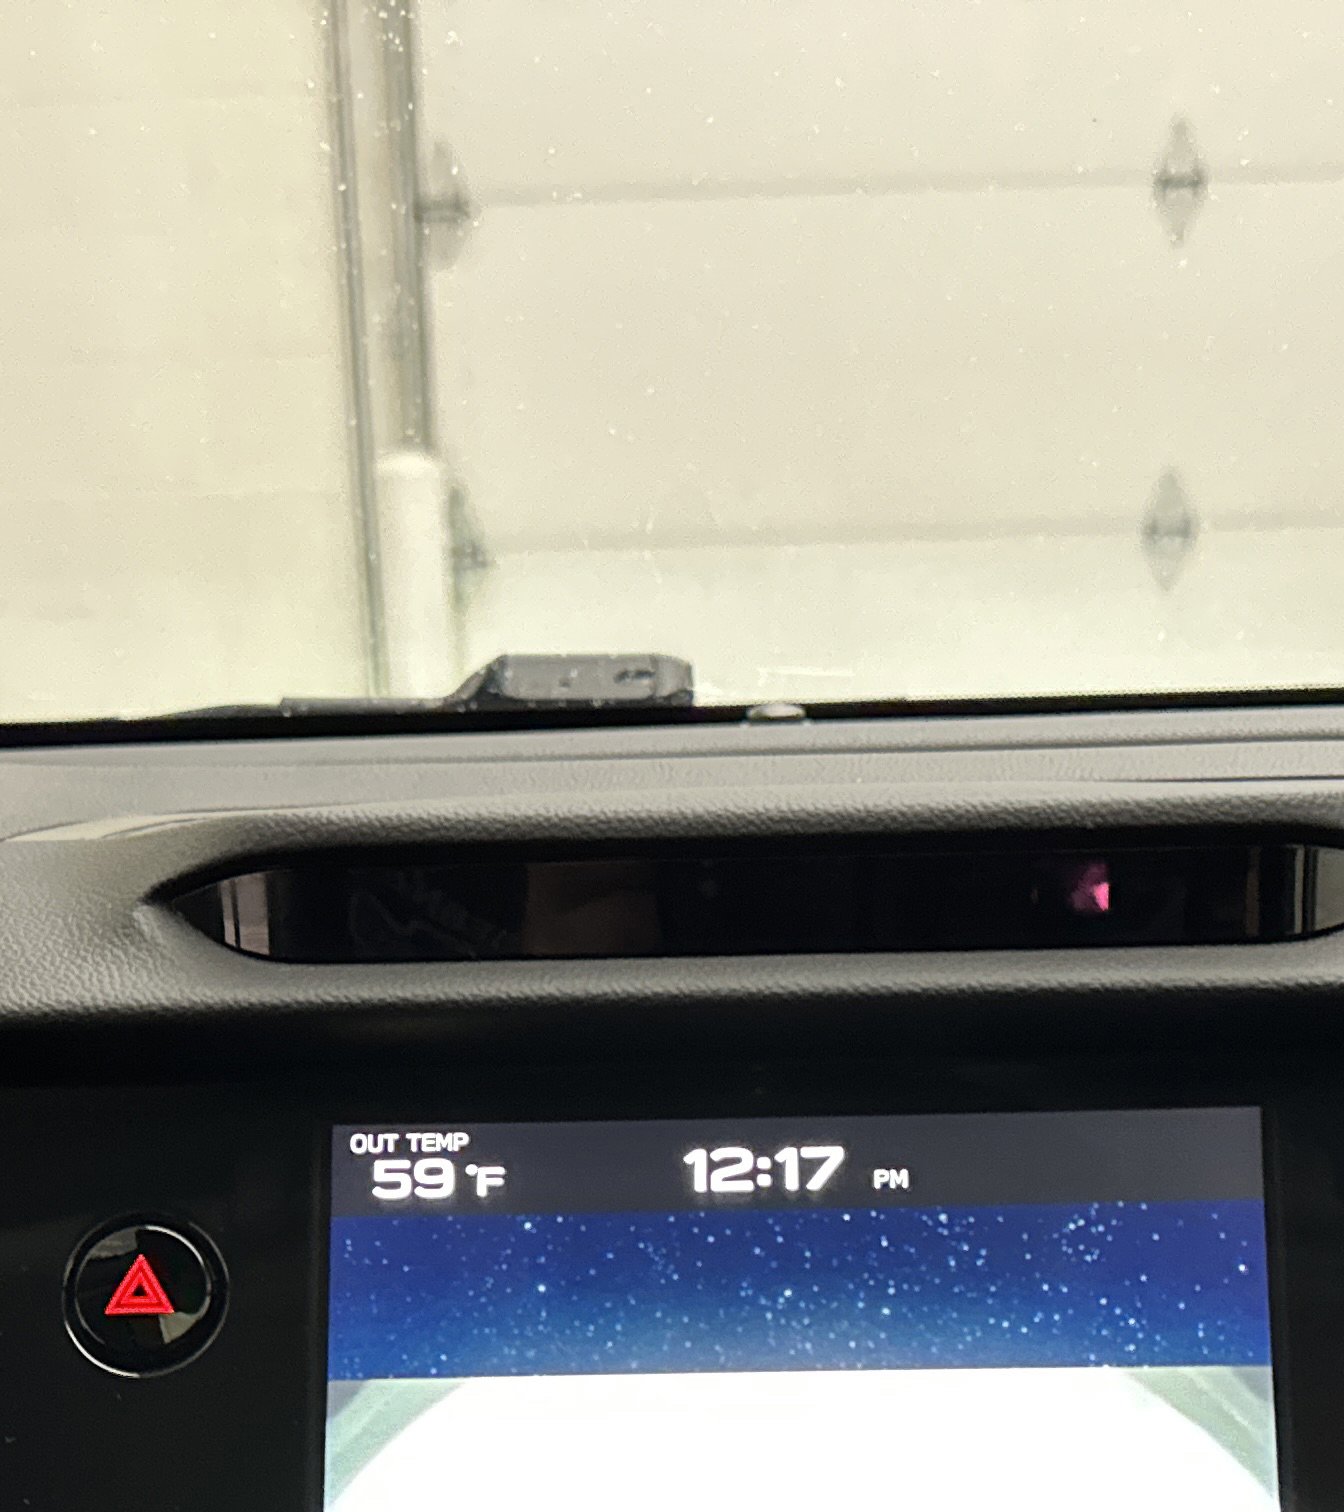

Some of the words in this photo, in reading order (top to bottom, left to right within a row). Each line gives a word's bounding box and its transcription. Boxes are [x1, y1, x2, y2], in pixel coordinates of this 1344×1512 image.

[349, 1133, 400, 1154] OUT
[405, 1132, 470, 1152] TEMP
[371, 1157, 455, 1199] 59
[683, 1145, 845, 1193] 12:17
[873, 1168, 909, 1190] PM
